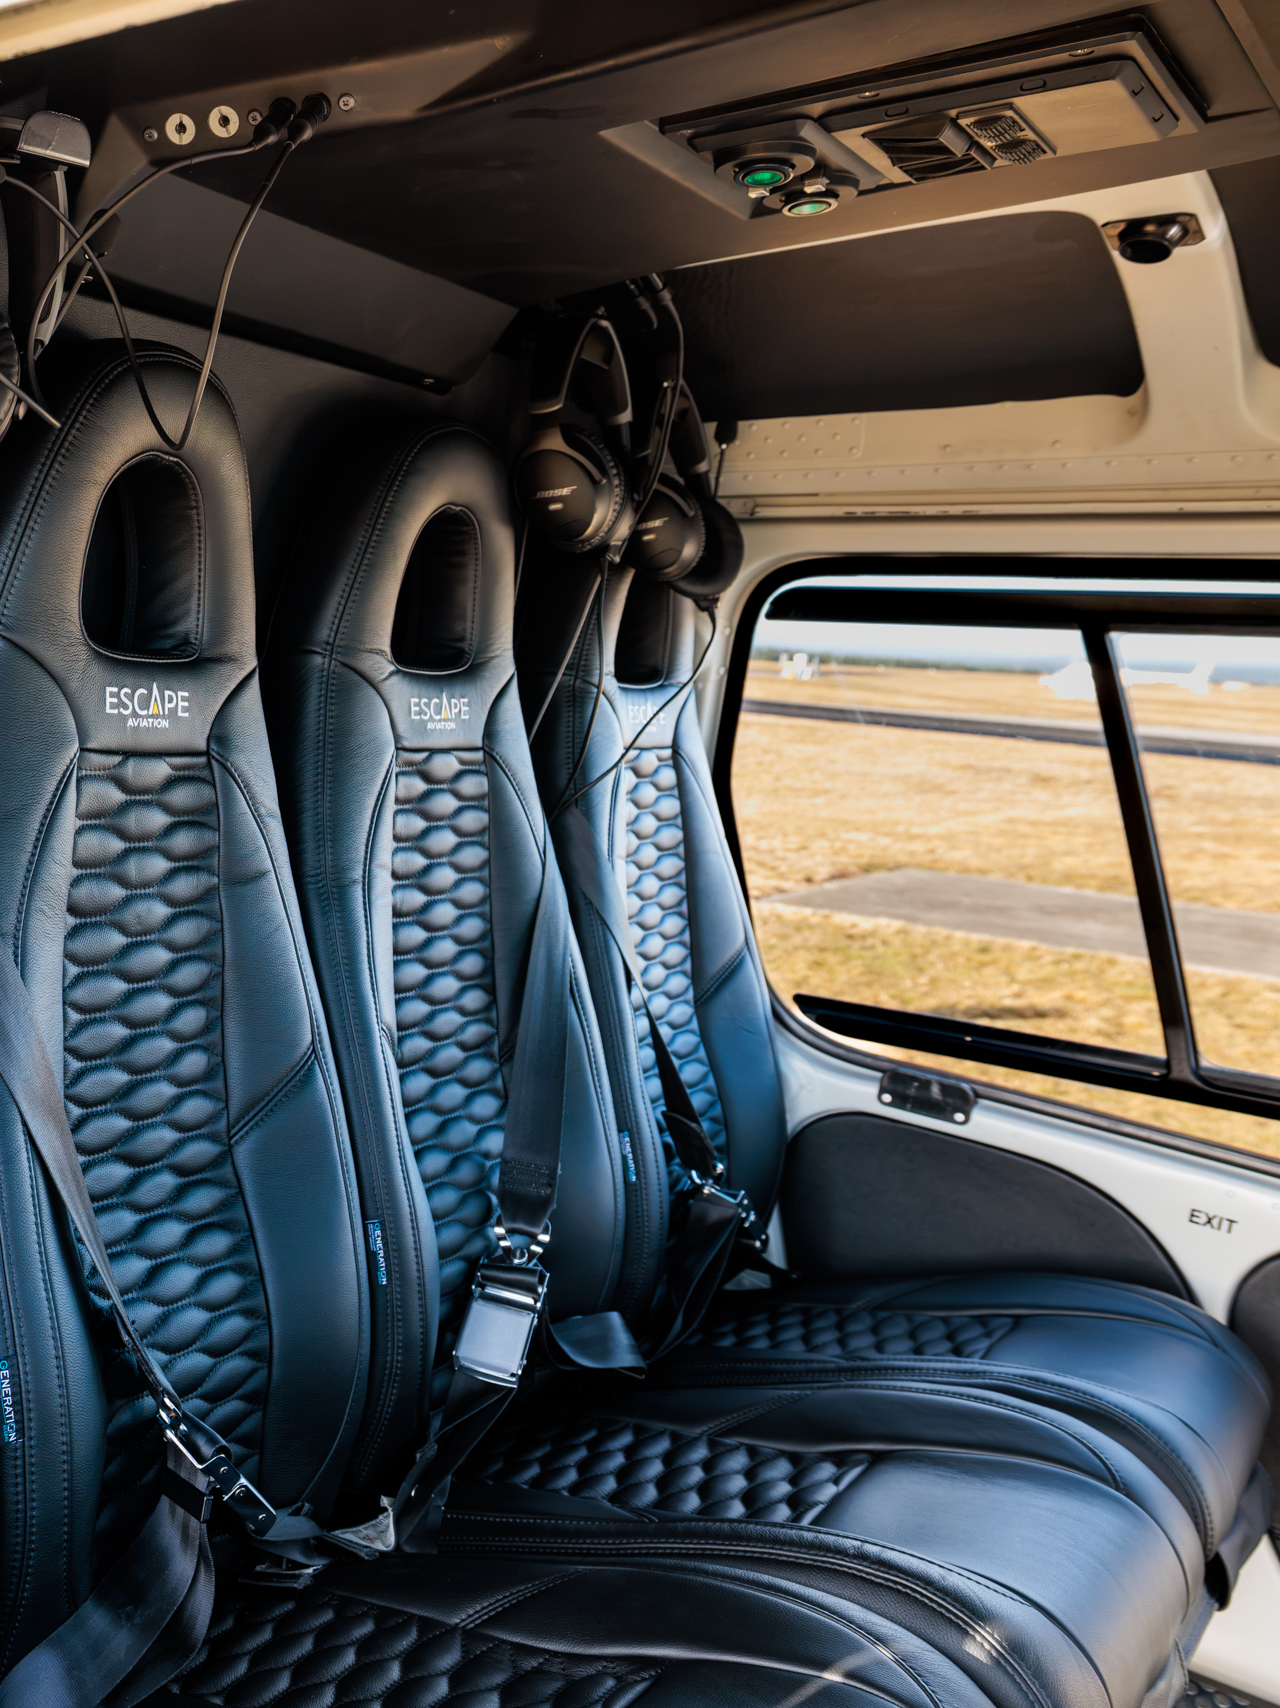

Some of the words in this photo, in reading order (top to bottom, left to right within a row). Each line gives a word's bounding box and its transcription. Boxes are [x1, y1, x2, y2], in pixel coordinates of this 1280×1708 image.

[530, 485, 578, 500] BOSE
[105, 681, 189, 717] ESCAPE
[410, 691, 470, 720] ESCAPE
[126, 717, 169, 729] AVIATION
[426, 721, 456, 730] AVIATION
[1188, 1208, 1238, 1234] EXIT
[374, 1222, 387, 1285] GENERATION
[0, 1360, 18, 1442] GENERATION
